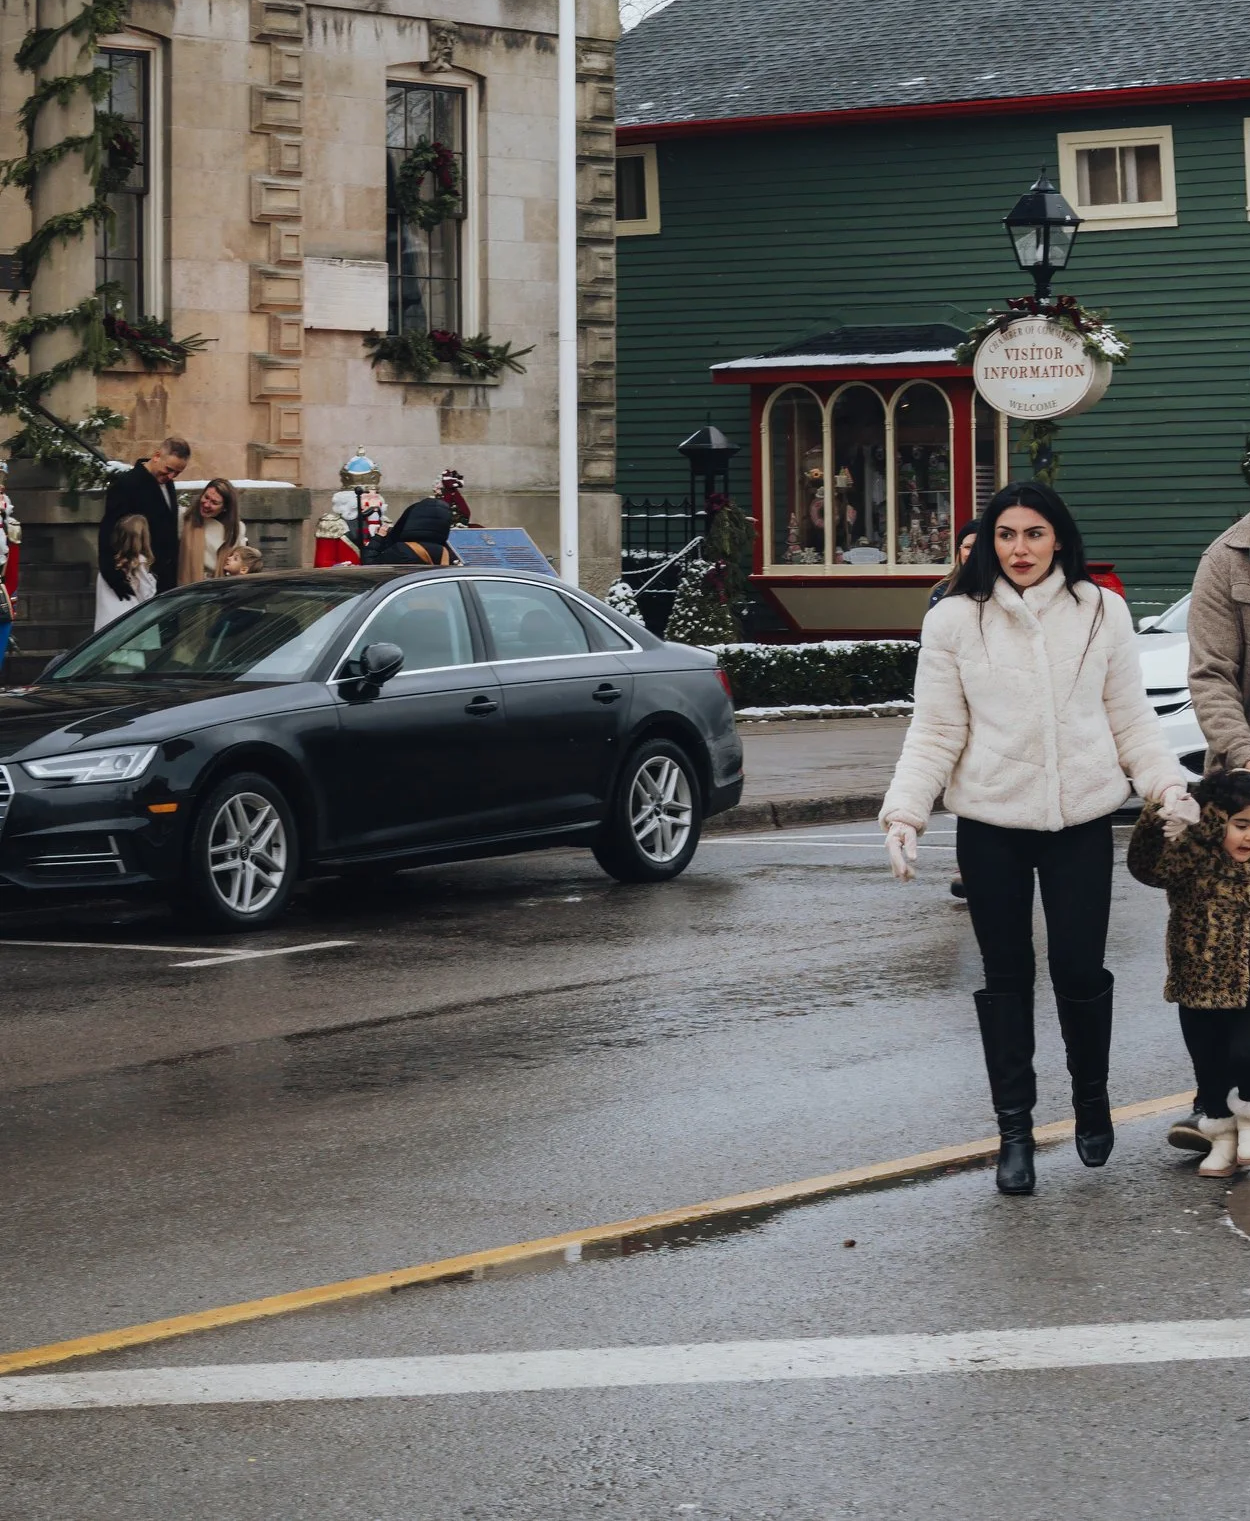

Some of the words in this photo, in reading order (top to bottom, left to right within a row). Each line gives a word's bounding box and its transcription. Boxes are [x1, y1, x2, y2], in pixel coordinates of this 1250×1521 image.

[988, 328, 1023, 354] CHAMBER
[1025, 325, 1035, 335] OF
[1037, 325, 1079, 351] COMMERCE
[1004, 347, 1063, 361] VISITOR
[984, 364, 1085, 380] INFORMATION
[1009, 399, 1058, 412] WELCOME
